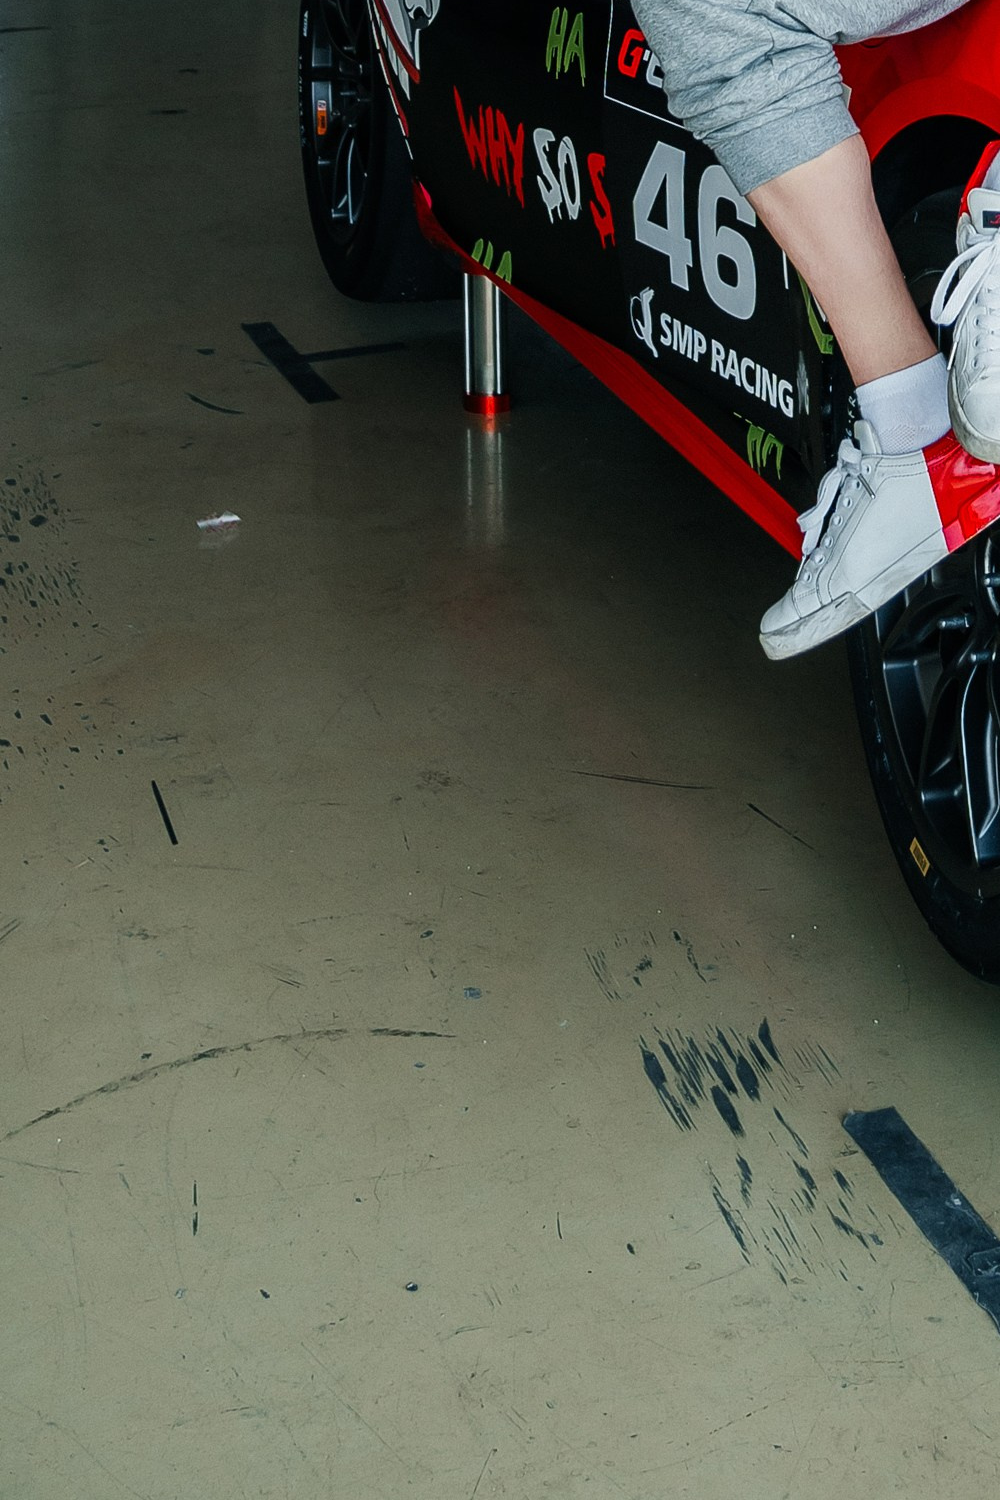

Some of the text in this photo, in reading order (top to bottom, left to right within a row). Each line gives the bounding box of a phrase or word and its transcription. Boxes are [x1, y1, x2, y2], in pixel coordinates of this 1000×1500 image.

[546, 6, 587, 88] HA
[454, 85, 525, 209] WHY
[533, 127, 583, 224] SO
[633, 140, 757, 321] 46
[660, 312, 795, 419] SMP RACING
